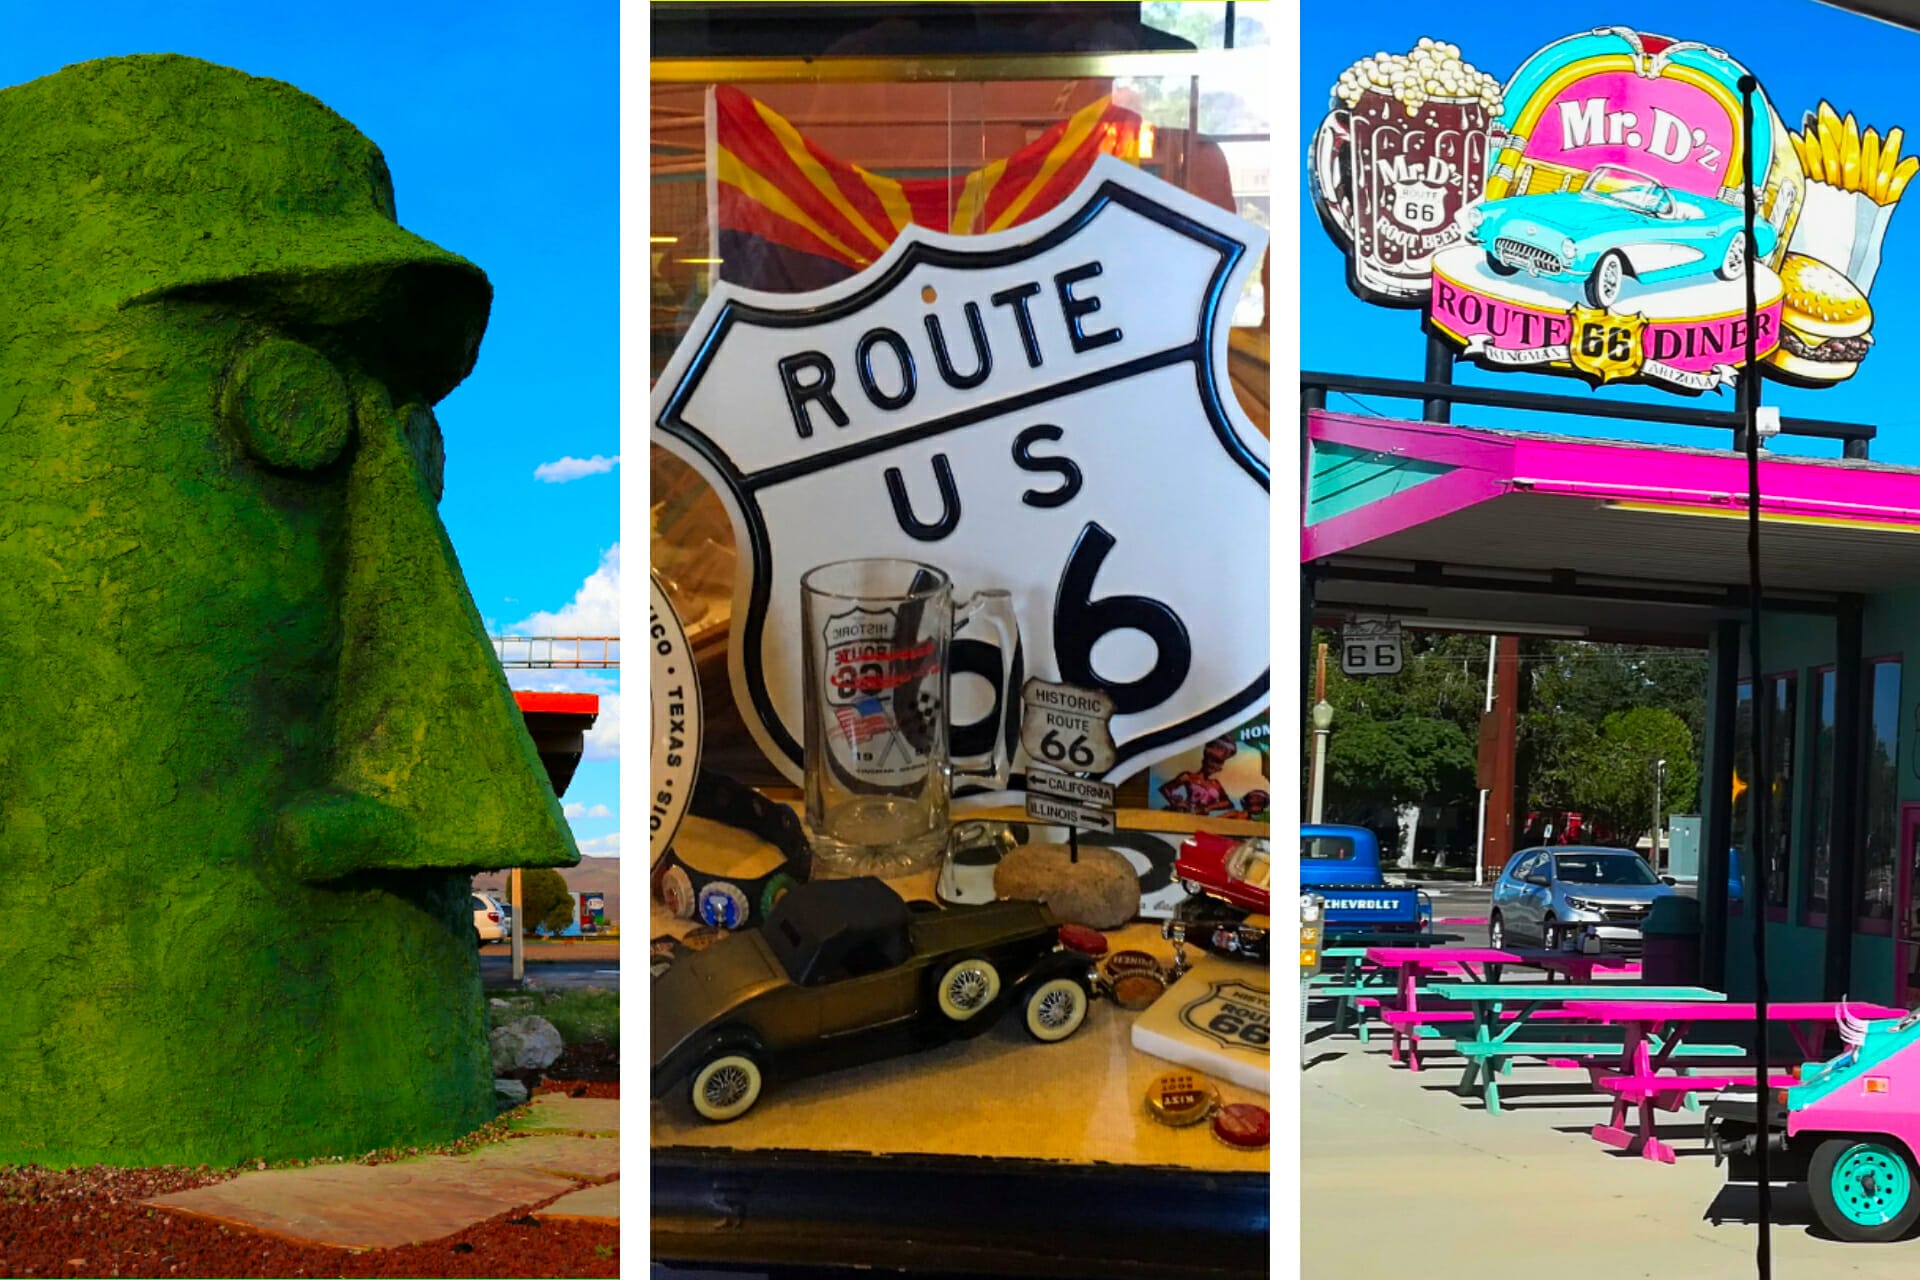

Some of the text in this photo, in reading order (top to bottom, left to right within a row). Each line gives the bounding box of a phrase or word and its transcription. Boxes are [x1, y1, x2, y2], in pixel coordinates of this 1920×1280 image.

[1556, 97, 1643, 151] Mr.
[1376, 154, 1425, 186] Mr.
[1405, 202, 1434, 222] 66
[1376, 215, 1461, 249] ROOT BEER
[1438, 281, 1568, 347] ROUTE
[777, 261, 1123, 438] ROUTE
[1581, 322, 1631, 362] 66
[1653, 312, 1771, 360] DINER
[1487, 347, 1562, 362] KINGMAN
[1649, 362, 1716, 388] ARIZONA
[1347, 644, 1396, 667] 66
[1035, 688, 1101, 713] HISTORIC
[667, 686, 685, 767] TEXAS
[1046, 713, 1090, 731] ROUTE
[1040, 729, 1095, 767] 66
[1048, 777, 1112, 801] CALIFORNIA
[1030, 803, 1079, 823] ILLINOIS
[1323, 899, 1400, 910] CHEVROLET
[1208, 1013, 1270, 1045] 66
